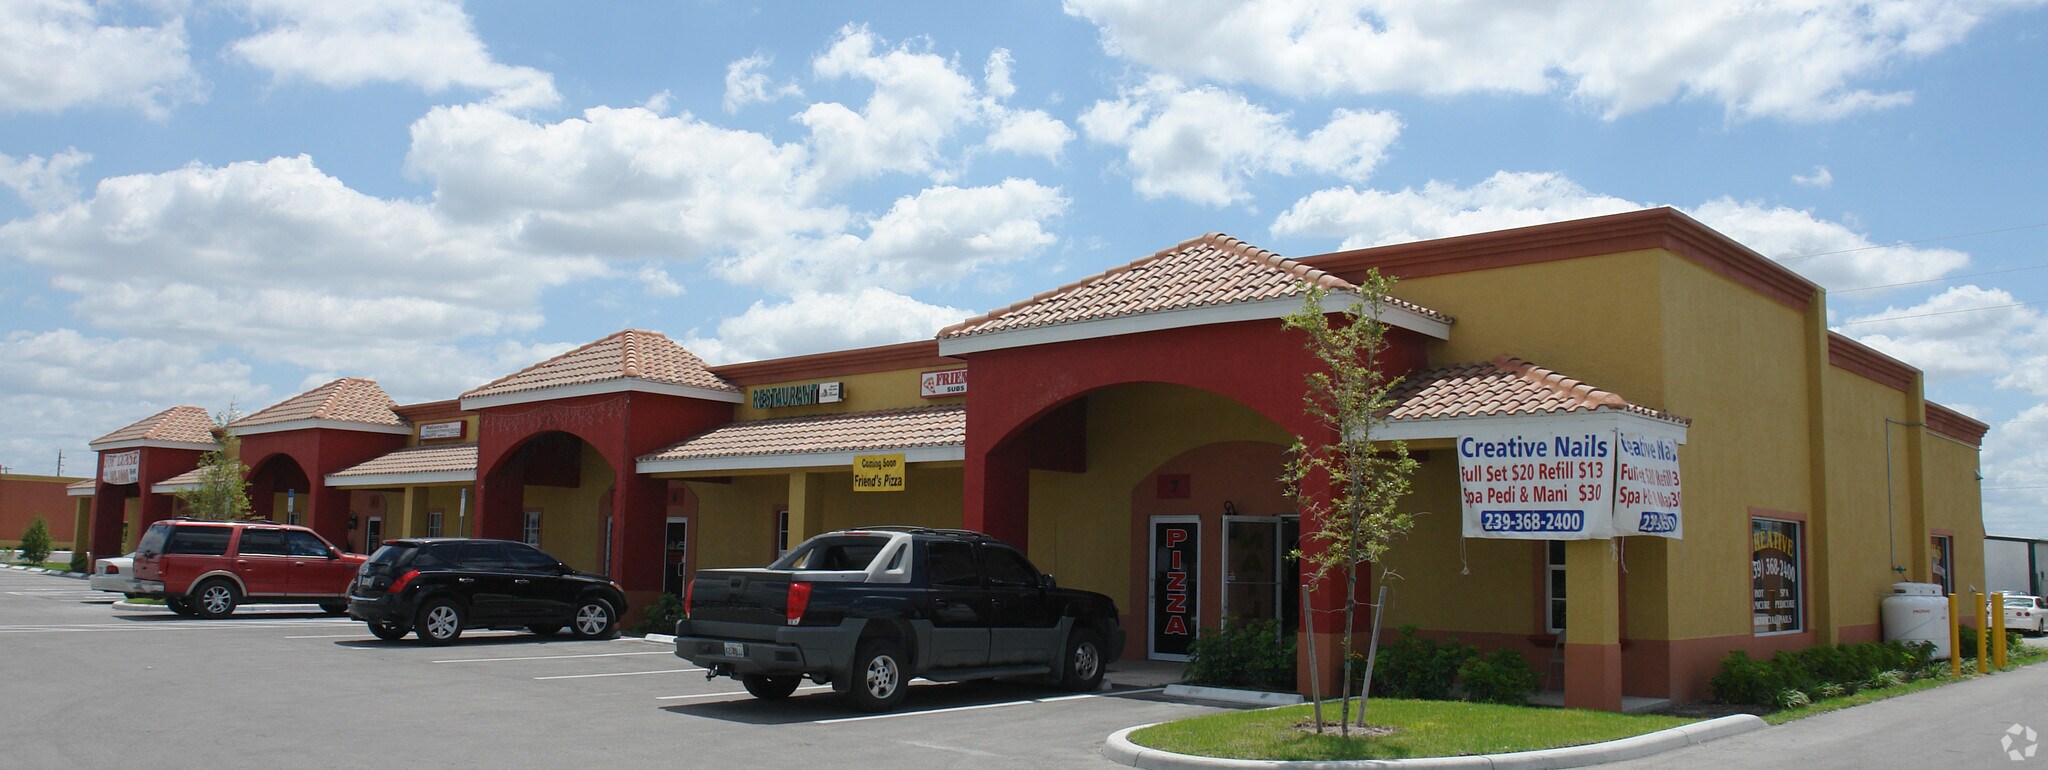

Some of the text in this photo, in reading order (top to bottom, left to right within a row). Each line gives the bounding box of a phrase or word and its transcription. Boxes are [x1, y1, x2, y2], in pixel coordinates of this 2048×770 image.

[936, 371, 967, 386] FRIEN
[753, 384, 818, 408] RESTAURANT
[1461, 434, 1608, 458] Creative Nails
[861, 458, 896, 470] Coming Soon
[1461, 460, 1603, 482] Full Set $20 Refill $13
[855, 474, 902, 487] Friend's Pizza
[1170, 480, 1180, 493] 7
[1464, 483, 1602, 507] Spa Pedi & Mani $30
[1619, 486, 1640, 508] Spa
[1485, 512, 1580, 530] 239-368-2400
[1753, 530, 1793, 557] REATIVE
[1753, 558, 1796, 583] 39) 368-2400
[1164, 529, 1188, 635] PIZZA
